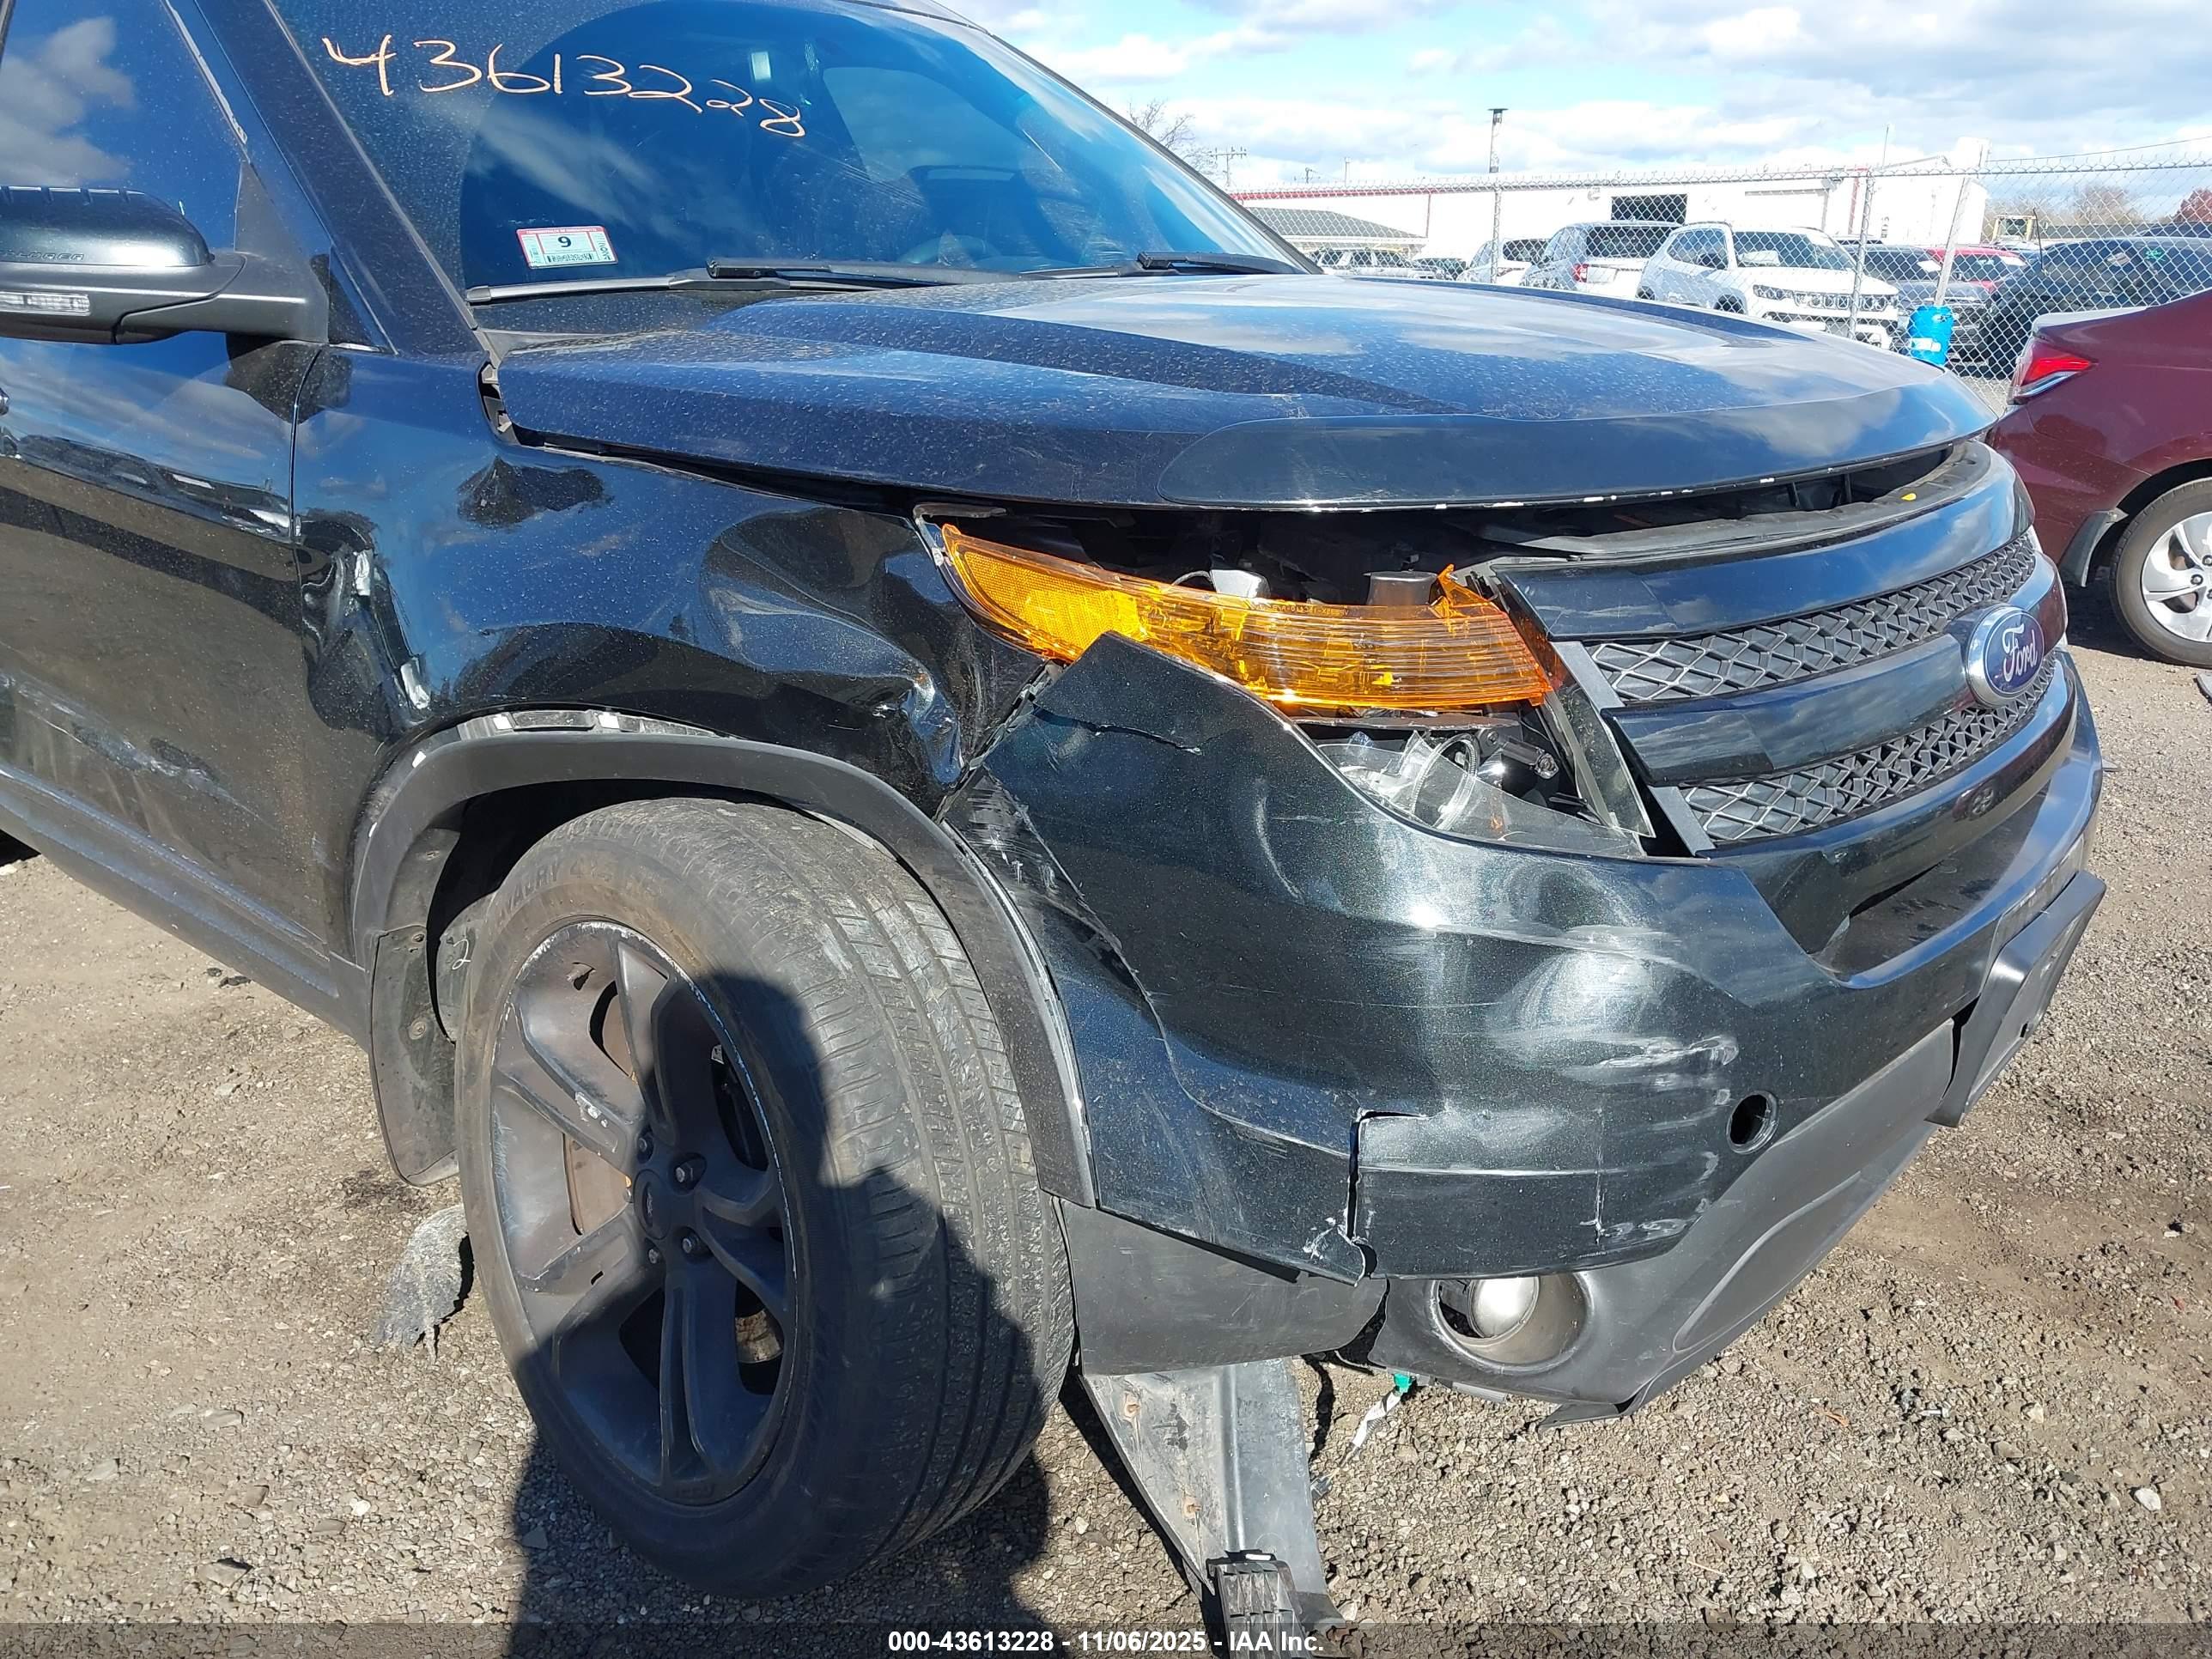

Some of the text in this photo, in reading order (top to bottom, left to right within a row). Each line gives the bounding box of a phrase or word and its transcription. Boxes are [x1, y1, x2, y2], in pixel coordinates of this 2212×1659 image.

[321, 33, 806, 138] 43613228
[557, 235, 572, 247] 9
[2002, 623, 2039, 683] Ford
